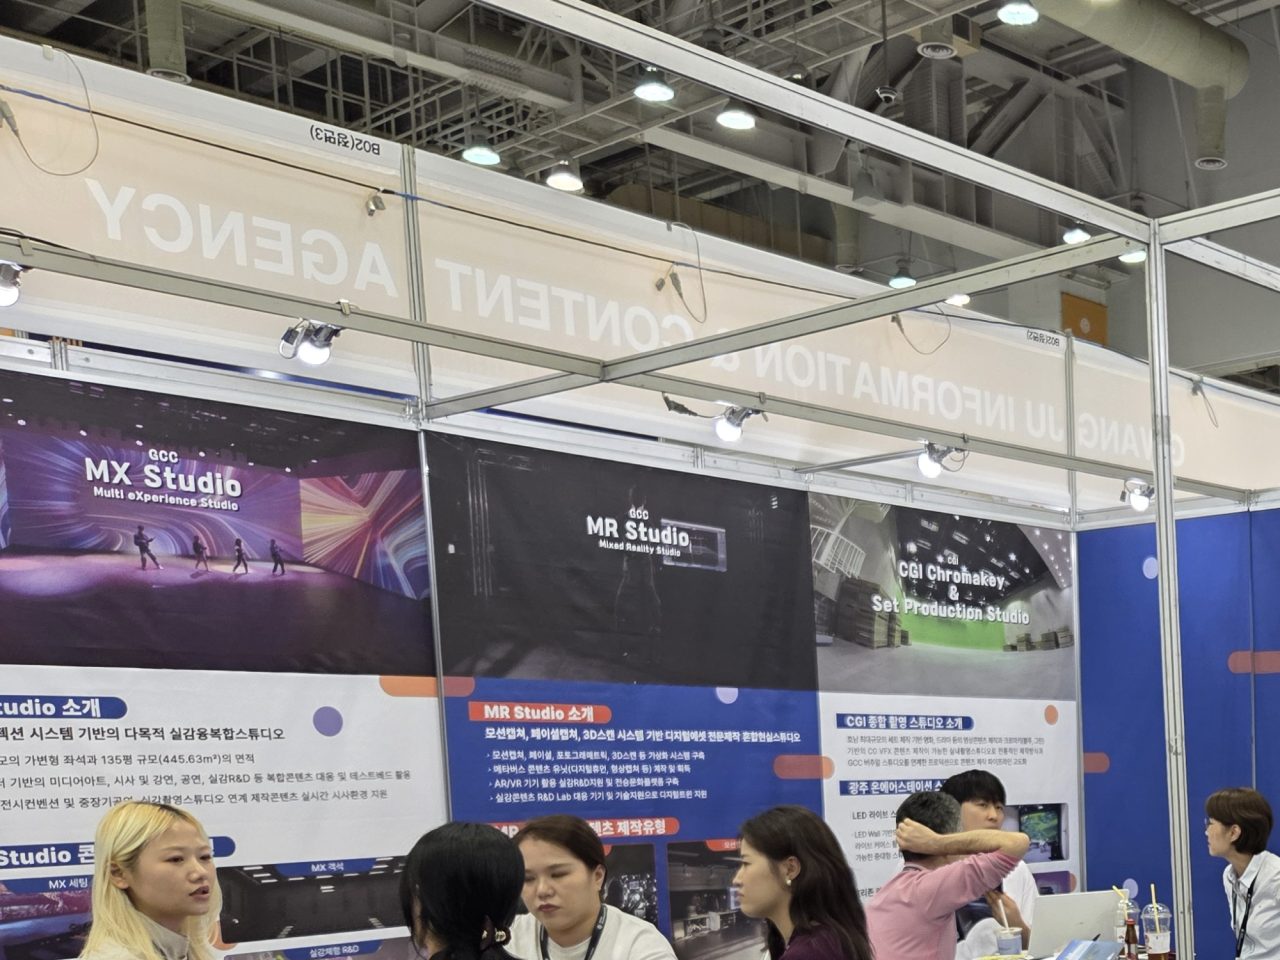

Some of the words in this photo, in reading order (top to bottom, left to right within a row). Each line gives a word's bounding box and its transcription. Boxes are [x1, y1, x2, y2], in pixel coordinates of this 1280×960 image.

[310, 125, 381, 155] B02(정면3)
[148, 448, 179, 464] GCC
[85, 457, 132, 487] MX
[144, 464, 243, 498] Studio
[94, 486, 124, 500] Multi
[128, 491, 197, 507] eXperience
[200, 497, 239, 511] Studio
[629, 508, 649, 520] GCC
[586, 515, 618, 539] MR
[625, 521, 690, 547] Studio
[599, 540, 624, 551] Mixed
[626, 542, 655, 555] Reality
[656, 545, 681, 557] Studio
[899, 560, 923, 579] CGI
[926, 563, 1006, 591] Chromakey
[949, 585, 960, 600] &
[871, 594, 900, 614] Set
[904, 598, 983, 621] Production
[986, 606, 1030, 626] Studio
[0, 698, 56, 716] udio
[62, 697, 101, 718] 소개
[484, 705, 510, 719] MR
[514, 705, 565, 720] Studio
[568, 705, 594, 722] 소개
[846, 716, 866, 727] CGI
[868, 716, 887, 729] 종합
[889, 716, 907, 729] 촬영
[909, 717, 944, 729] 스튜디오
[946, 717, 963, 730] 소개
[30, 727, 74, 741] 시스템
[78, 727, 119, 741] 기반의
[124, 727, 165, 741] 다목적
[169, 727, 286, 742] 실감융복합스튜디오
[583, 729, 616, 742] 3D스캔
[617, 729, 644, 742] 시스템
[646, 730, 664, 742] 기반
[25, 754, 60, 767] 가변형
[63, 754, 97, 766] 좌석과
[101, 754, 133, 766] 135평
[235, 753, 255, 765] 면적
[670, 751, 691, 760] 시스템
[527, 764, 551, 774] 콘텐츠
[10, 776, 46, 789] 기반의
[50, 775, 111, 788] 미디어아트,
[114, 775, 134, 786] 시사
[138, 774, 149, 786] 및
[153, 774, 178, 787] 강연,
[181, 774, 205, 786] 공연,
[208, 773, 250, 785] 실감R&D
[254, 773, 263, 784] 등
[267, 772, 313, 783] 복합콘텐츠
[494, 779, 522, 789] AR/VR
[524, 779, 540, 788] 기기
[848, 781, 869, 795] 광주
[63, 798, 75, 809] 및
[227, 793, 248, 804] 연계
[250, 792, 299, 803] 제작콘텐츠
[301, 791, 329, 801] 실시간
[537, 792, 555, 801] R&D
[852, 811, 867, 820] LED
[869, 810, 889, 819] 라이브
[617, 818, 666, 835] 제작유형
[0, 846, 72, 866] Studio
[311, 863, 326, 873] MX
[49, 880, 67, 890] MX
[69, 877, 88, 889] 세팅
